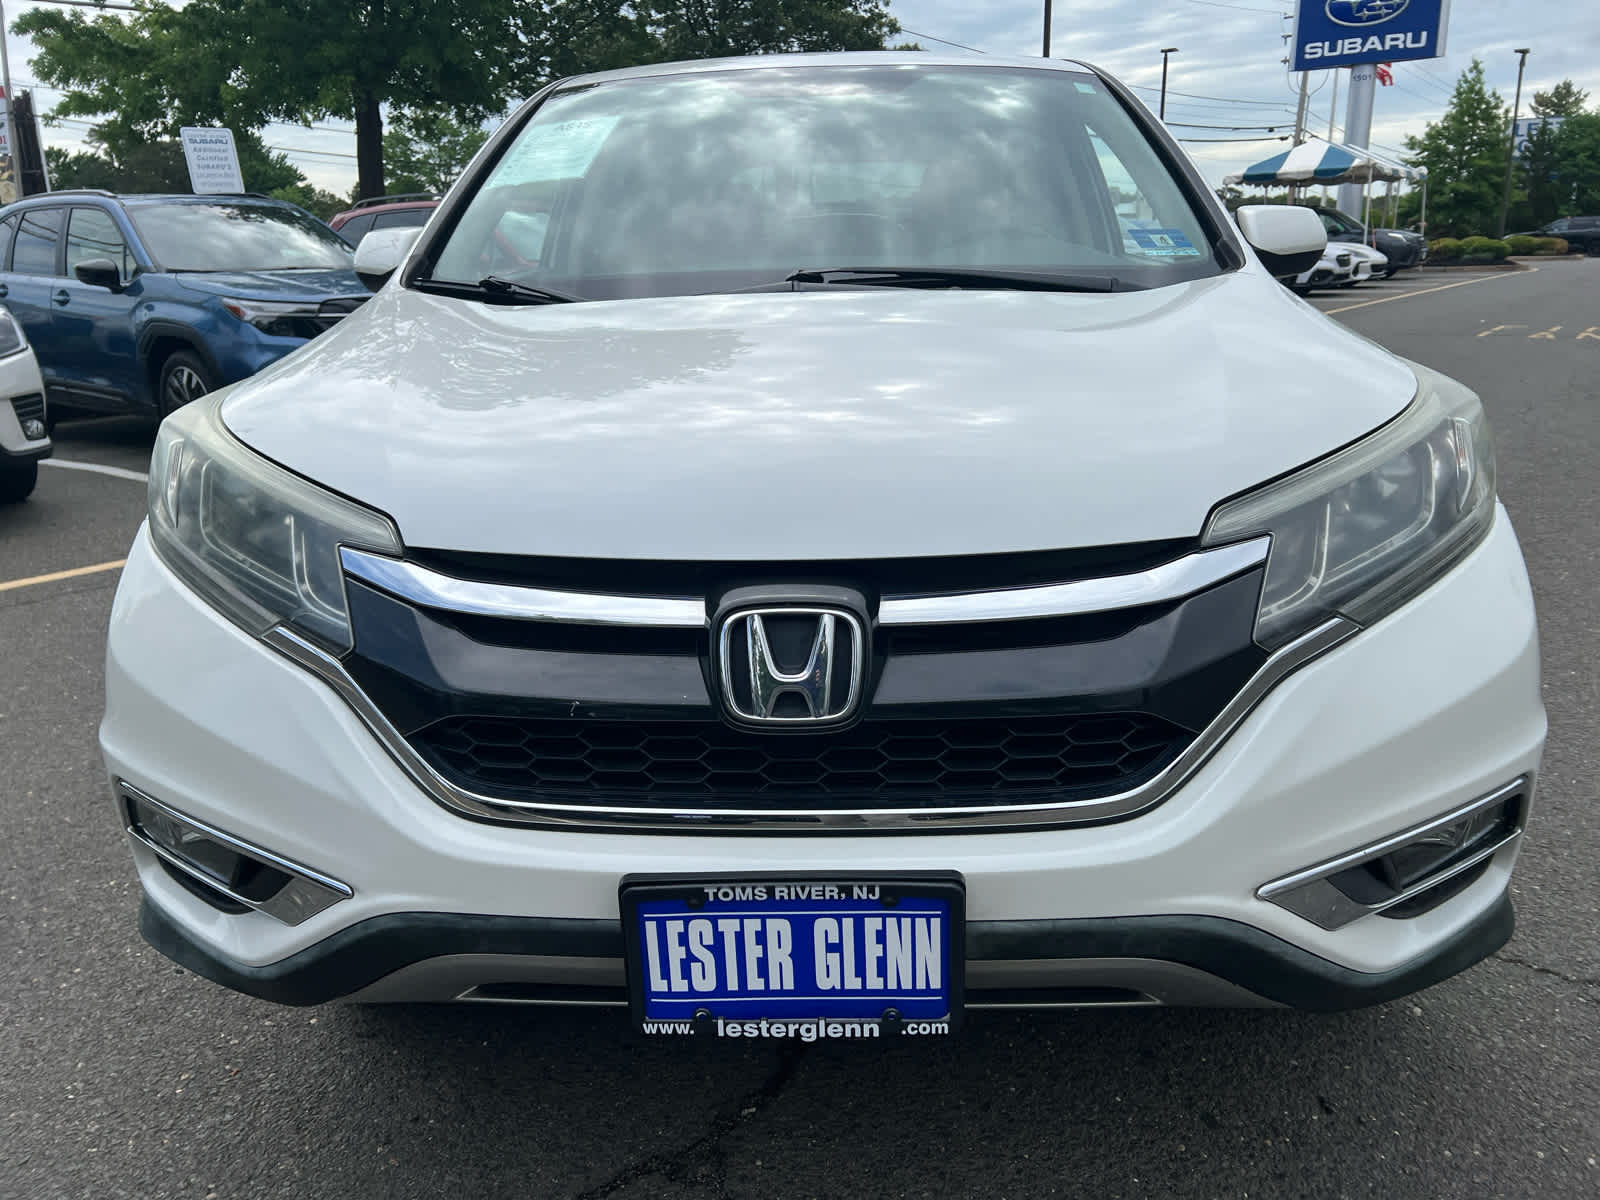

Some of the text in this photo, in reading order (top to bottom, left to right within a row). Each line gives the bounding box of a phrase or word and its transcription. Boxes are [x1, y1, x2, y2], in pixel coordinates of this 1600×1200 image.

[1304, 31, 1427, 59] SUBARU
[704, 885, 881, 901] TOMS RIVER, NJ
[645, 917, 942, 992] LESTER GLENN
[642, 1019, 949, 1042] www. lesterglenn .com
